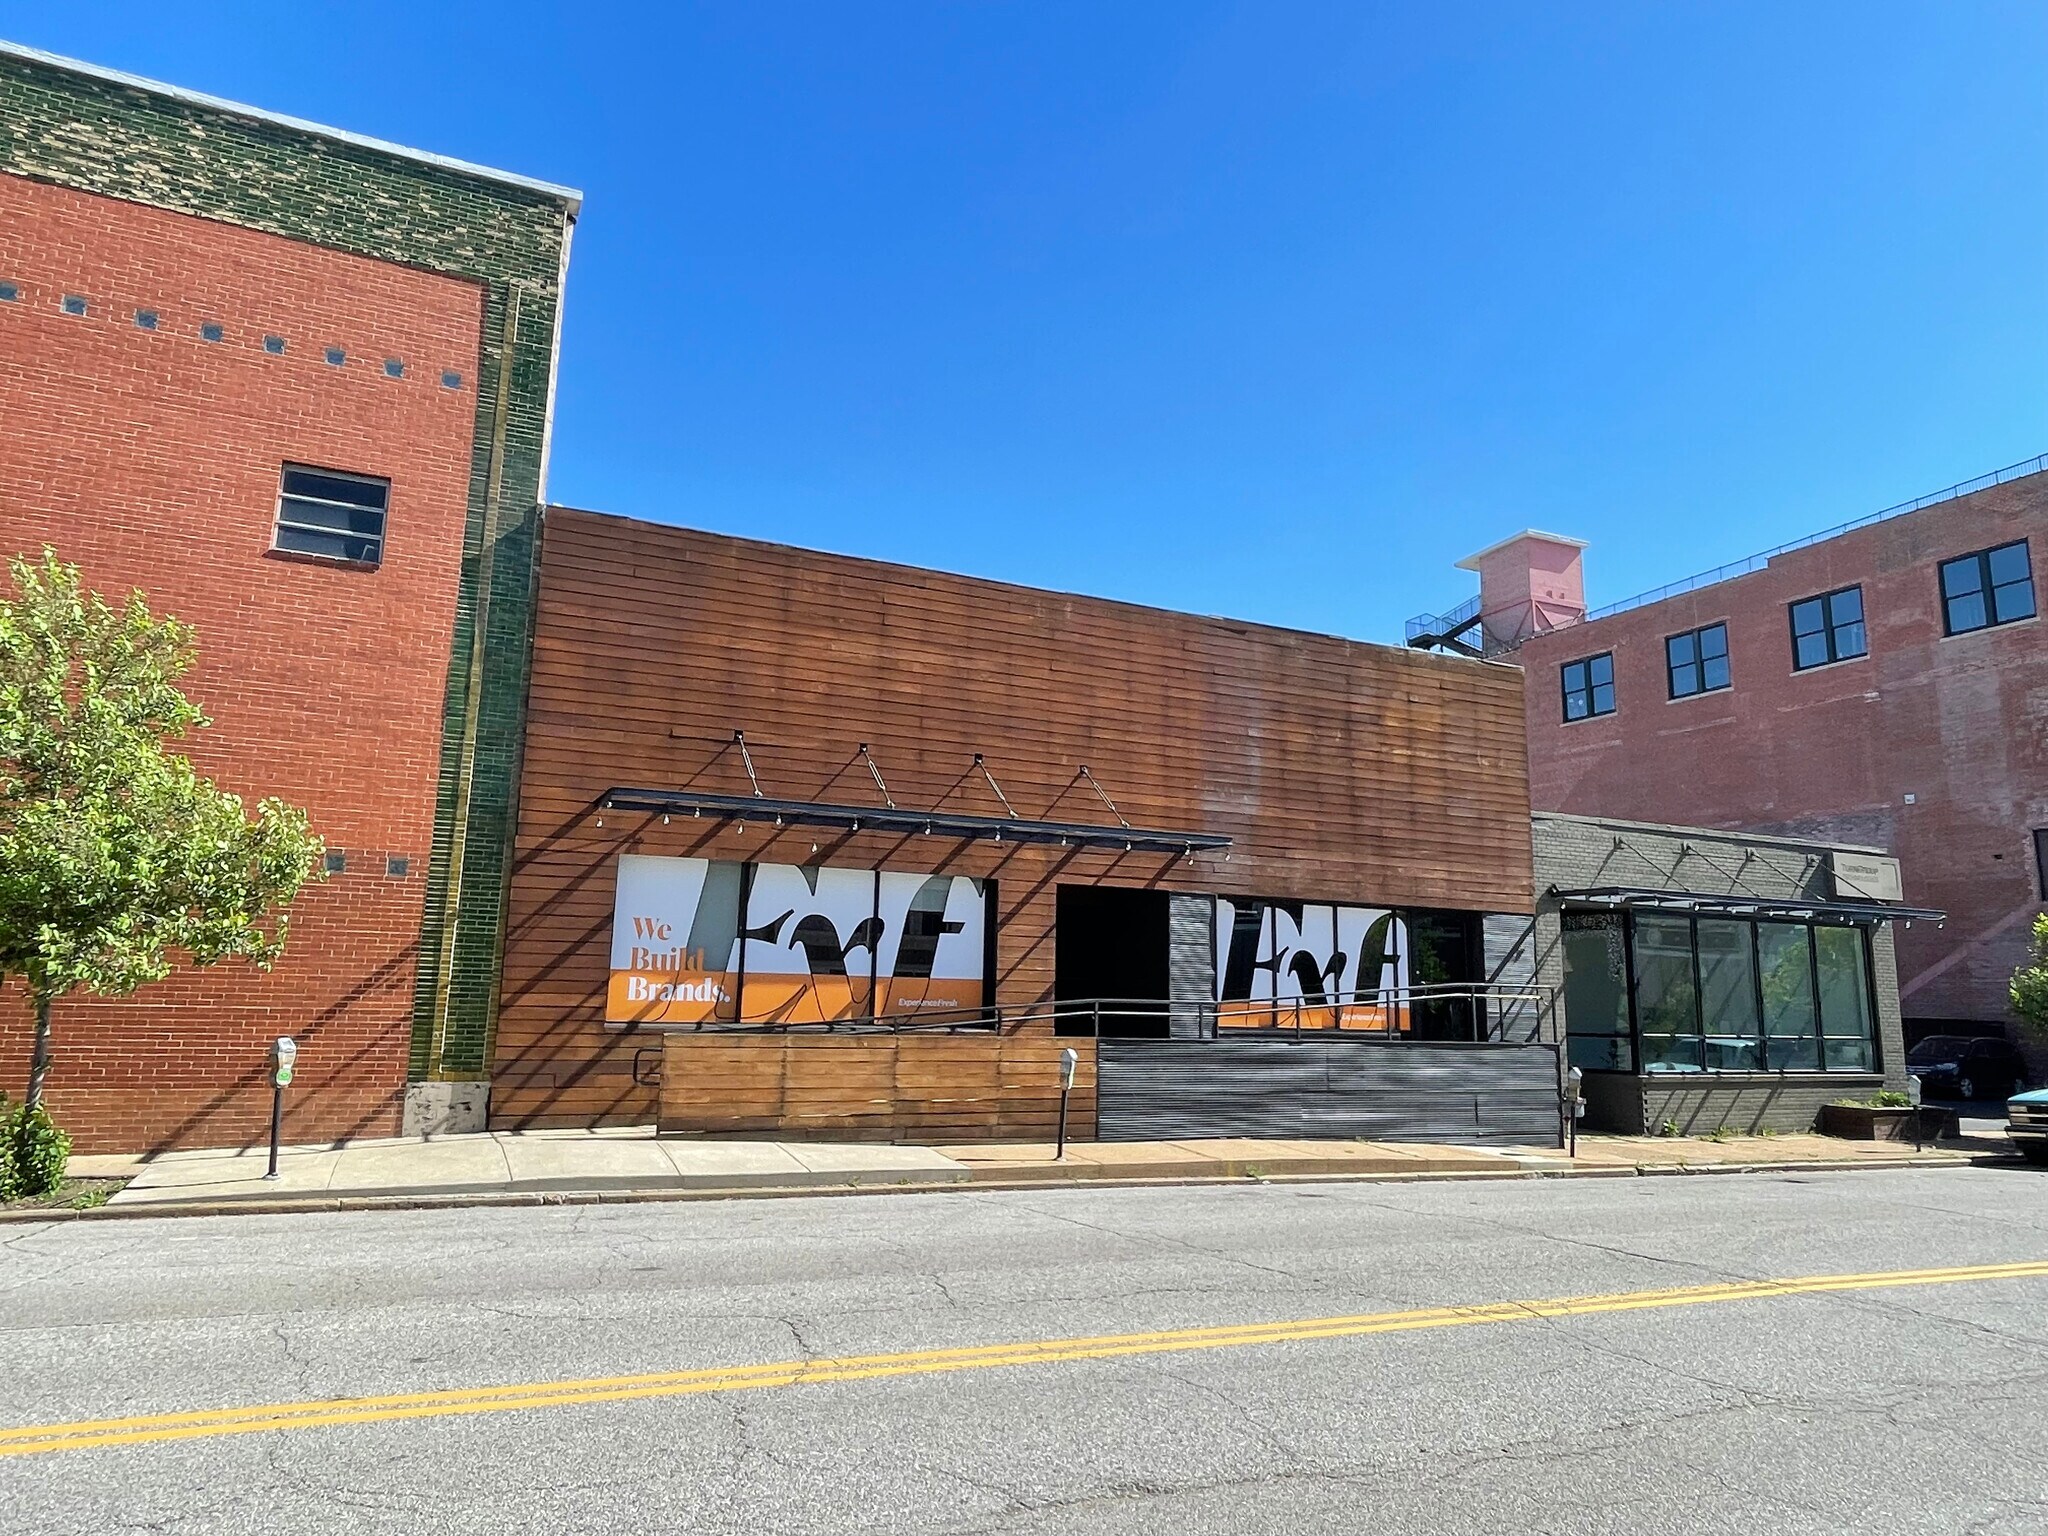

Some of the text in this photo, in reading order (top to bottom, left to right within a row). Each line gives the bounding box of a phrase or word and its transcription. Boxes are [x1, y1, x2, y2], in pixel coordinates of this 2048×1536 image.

[633, 916, 672, 941] We
[630, 946, 705, 972] Build
[627, 976, 731, 1003] Brands.
